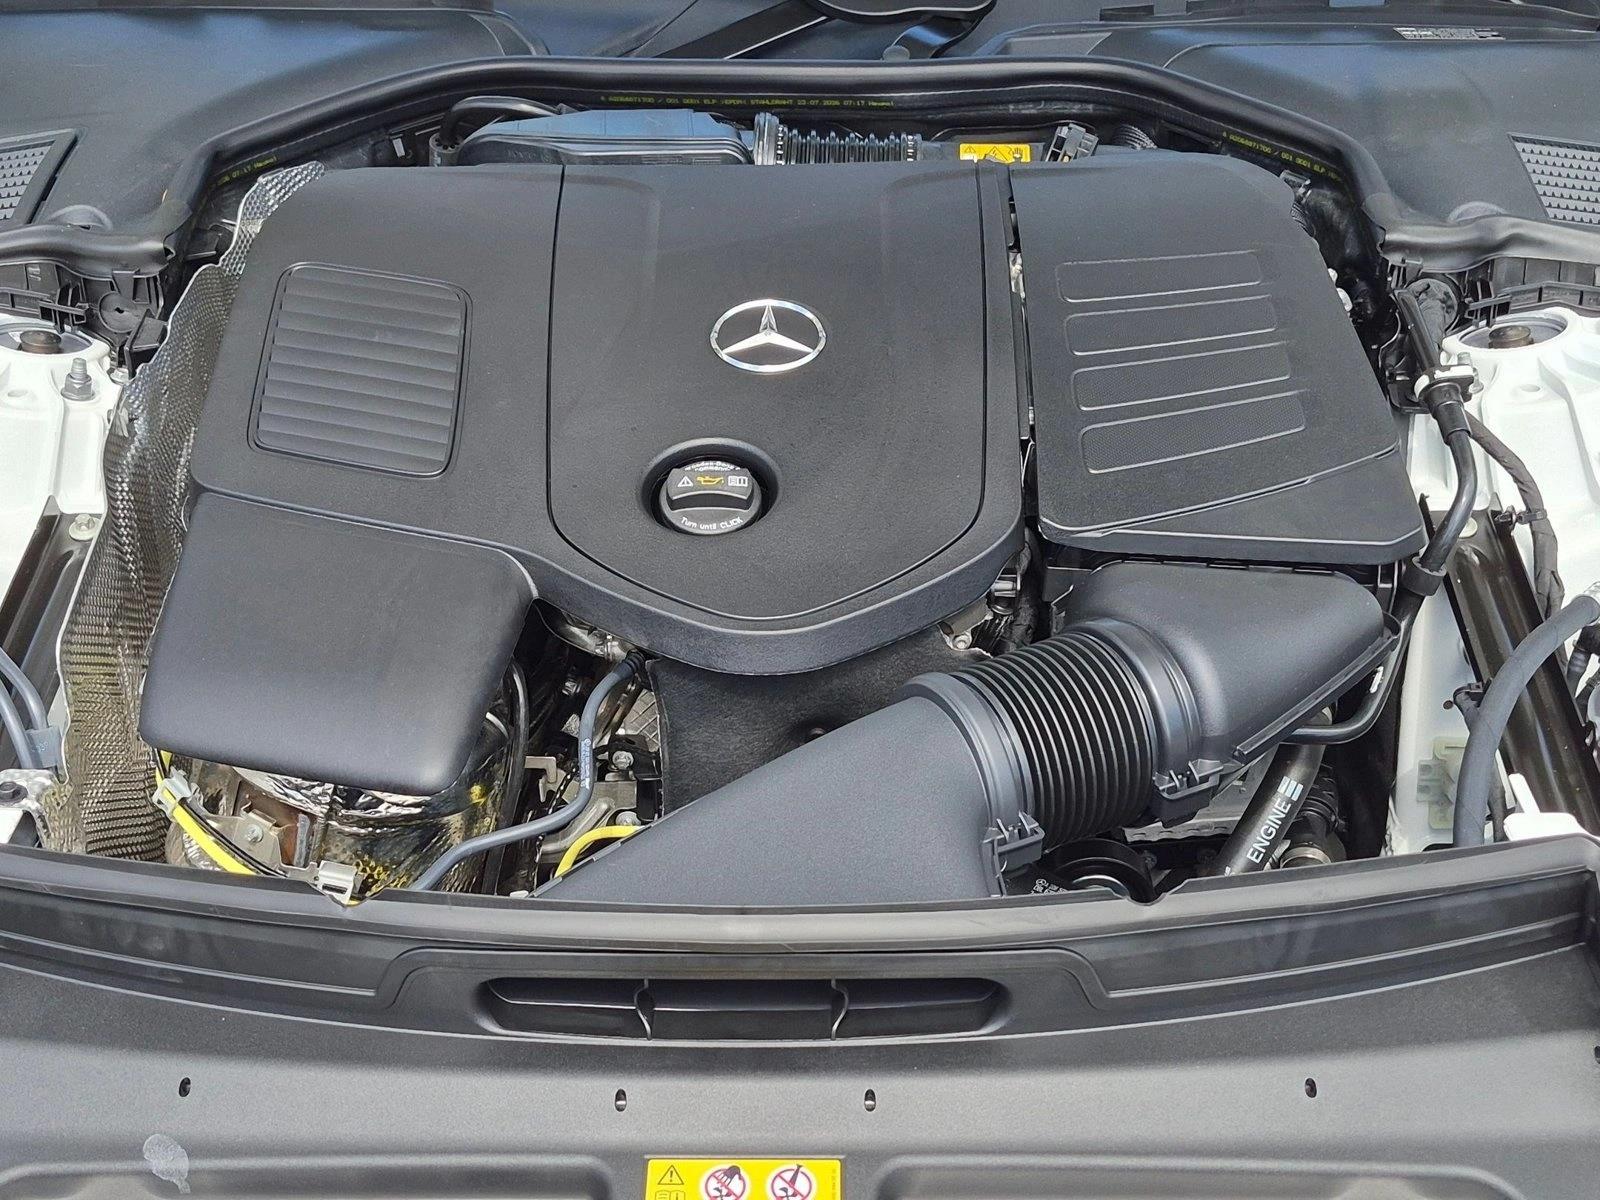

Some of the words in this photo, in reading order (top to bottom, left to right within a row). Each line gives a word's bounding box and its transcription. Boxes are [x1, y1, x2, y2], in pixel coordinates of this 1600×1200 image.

[681, 516, 698, 528] Turn
[720, 516, 743, 529] CLICK
[1246, 797, 1292, 864] ENGINE
